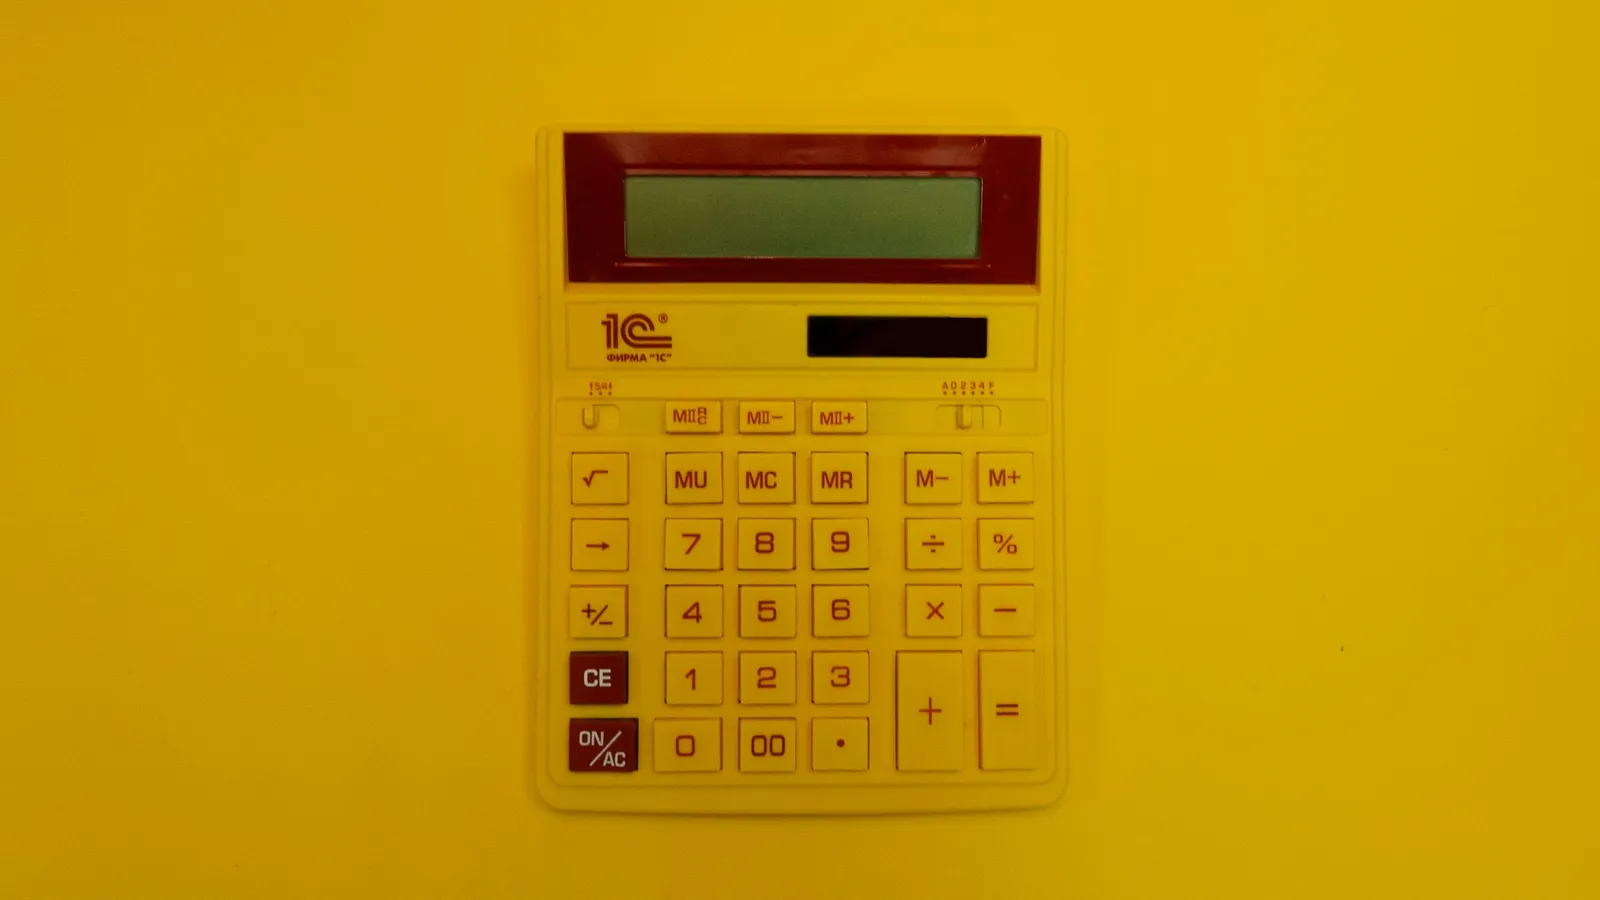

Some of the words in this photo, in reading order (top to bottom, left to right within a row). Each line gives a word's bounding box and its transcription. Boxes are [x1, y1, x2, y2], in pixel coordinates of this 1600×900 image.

[606, 353, 647, 363] ФИРМА
[674, 470, 708, 489] MU
[745, 470, 778, 490] MC
[821, 470, 853, 489] MR
[988, 469, 1021, 487] M+
[681, 532, 702, 555] 7
[754, 531, 775, 554] 8
[830, 530, 851, 553] 9
[681, 601, 703, 624] 4
[757, 599, 777, 623] 5
[830, 598, 851, 622] 6
[583, 668, 612, 688] CE
[684, 668, 697, 691] 1
[756, 666, 777, 689] 2
[830, 665, 851, 688] 3
[675, 734, 696, 757] 0
[750, 734, 786, 757] 00
